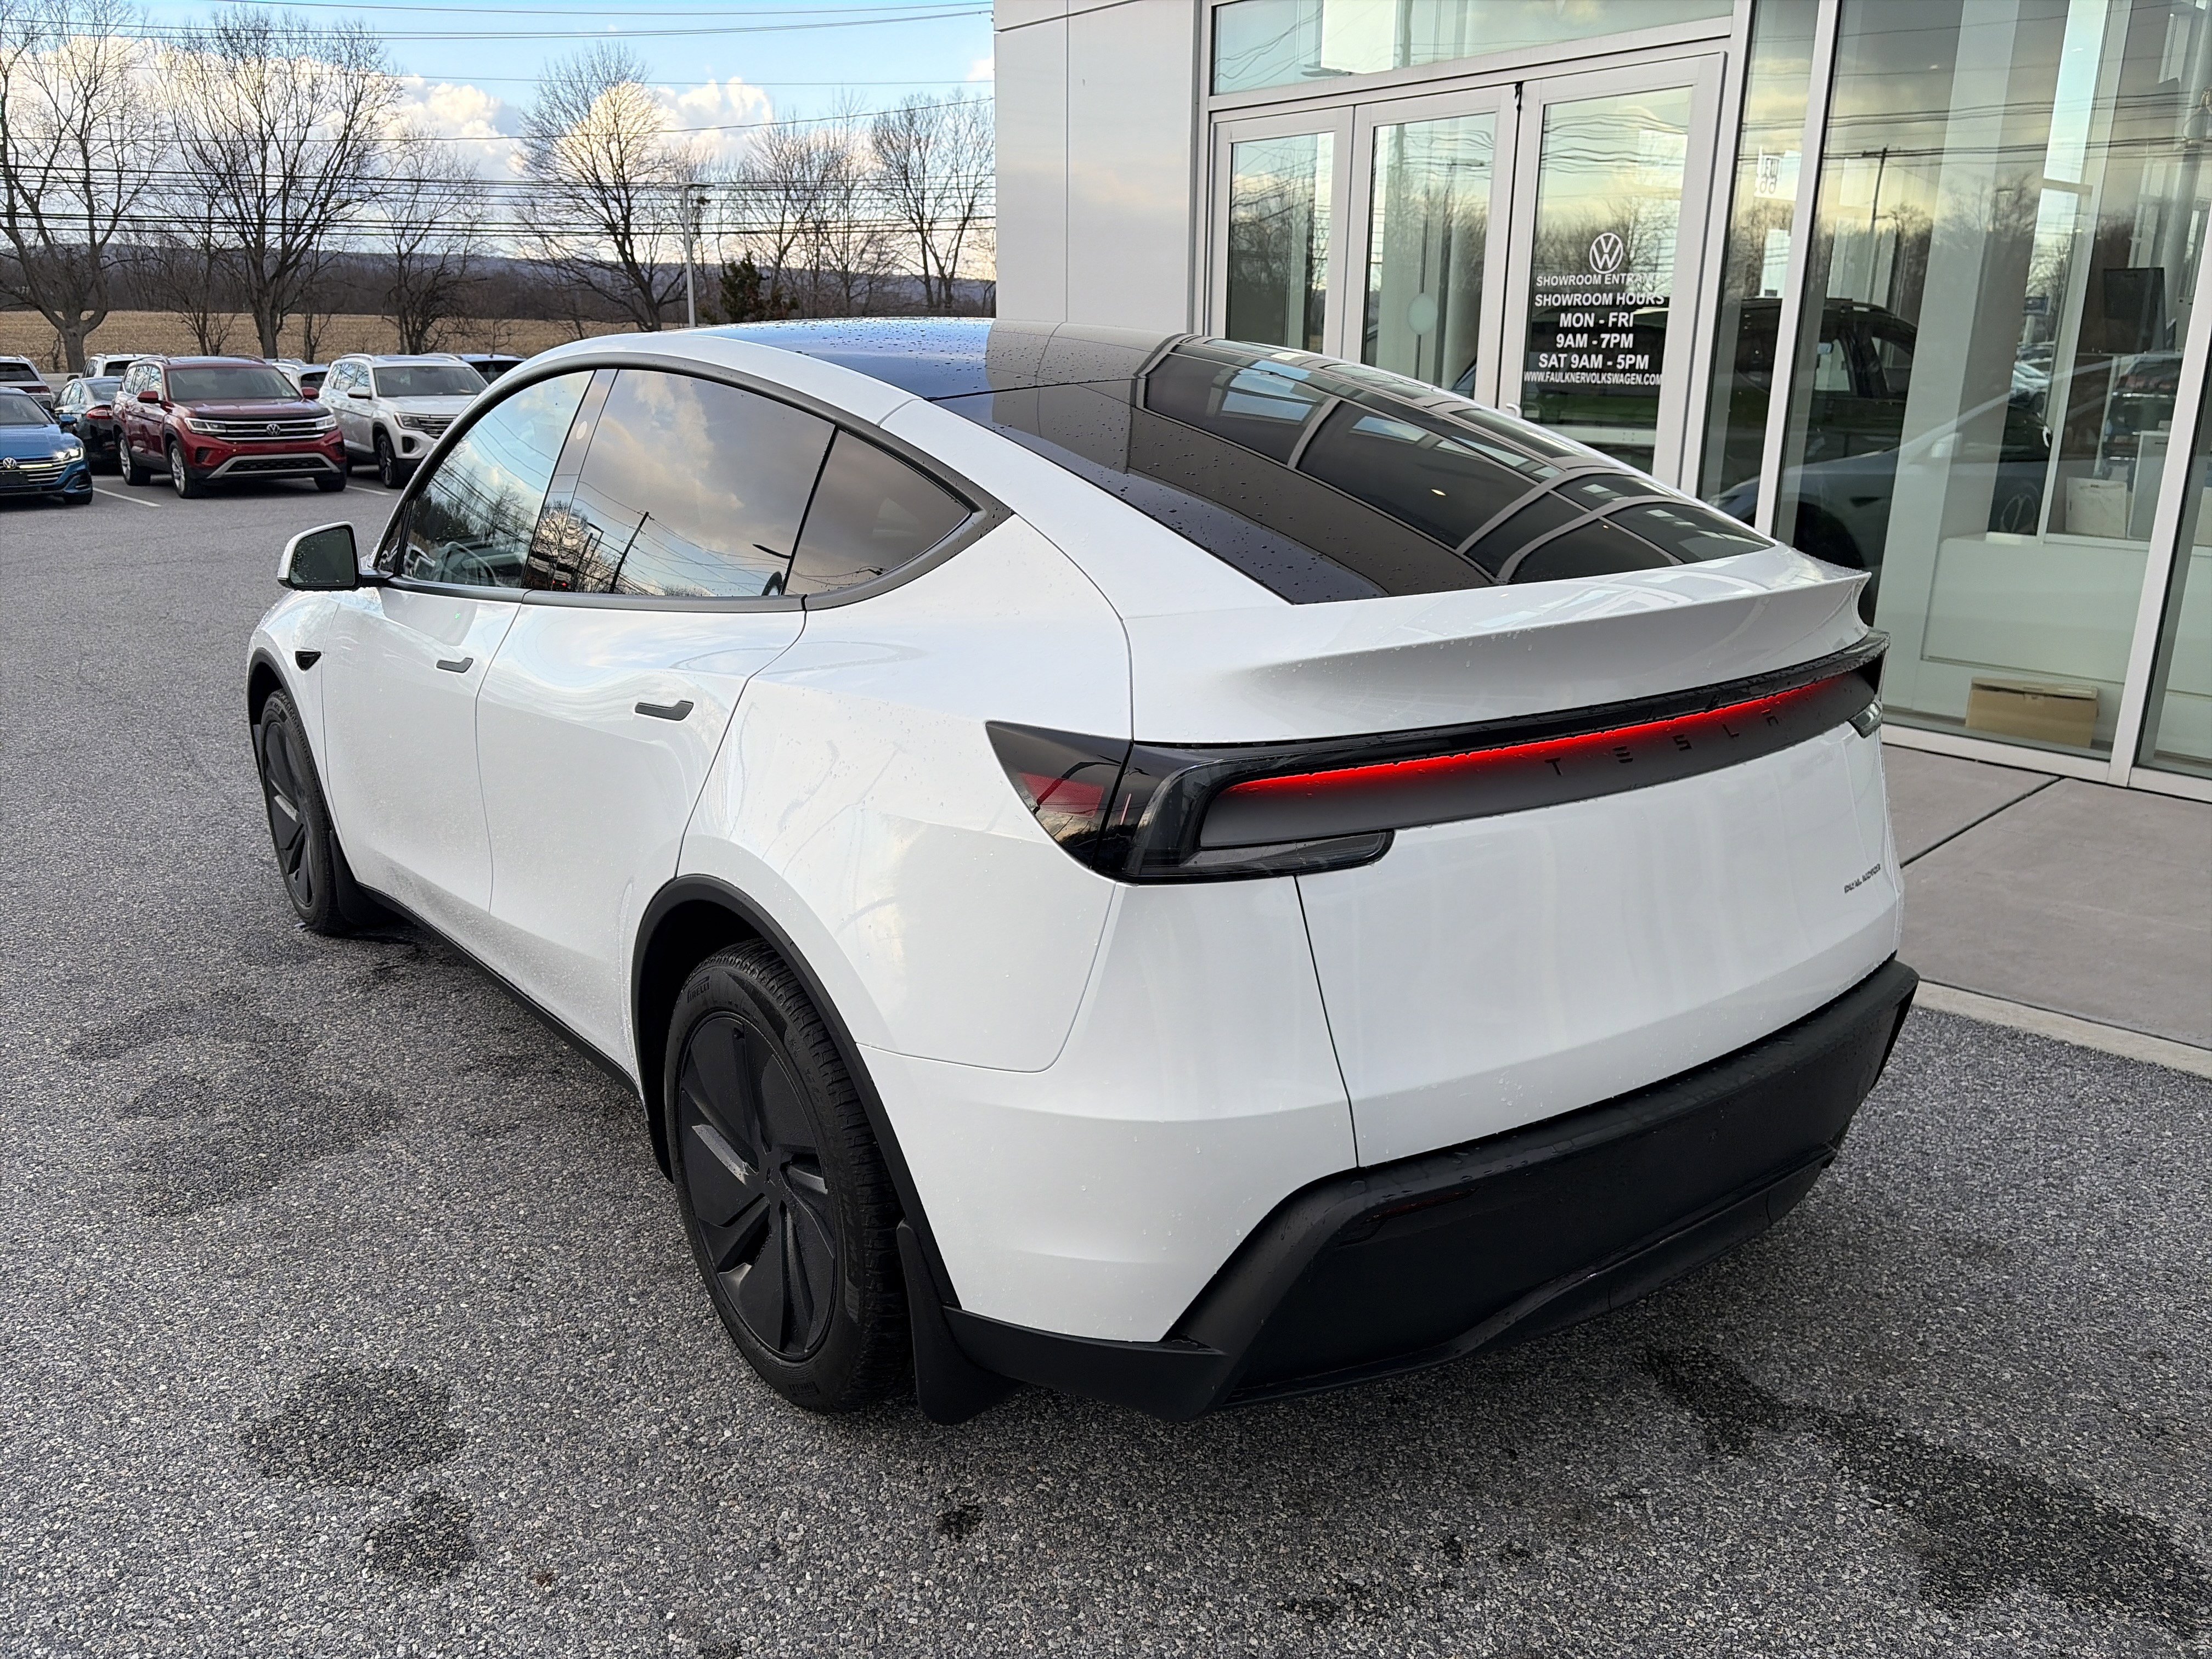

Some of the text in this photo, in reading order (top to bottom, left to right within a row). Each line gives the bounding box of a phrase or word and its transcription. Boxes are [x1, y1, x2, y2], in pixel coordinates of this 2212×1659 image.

[1536, 274, 1602, 287] SHOWROOM
[1534, 291, 1665, 307] SHOWROOM HOURS
[1559, 312, 1595, 328] MON
[1608, 312, 1634, 328] FRI
[1556, 333, 1588, 348] 9AM
[1600, 333, 1634, 348] 7PM
[1538, 353, 1567, 368] SAT
[1571, 354, 1603, 369] 9AM
[1616, 354, 1650, 370] 5PM
[1523, 371, 1662, 385] WWW.FAULKNERVOLKSWAGEN.COM
[1544, 708, 1779, 776] TESLA
